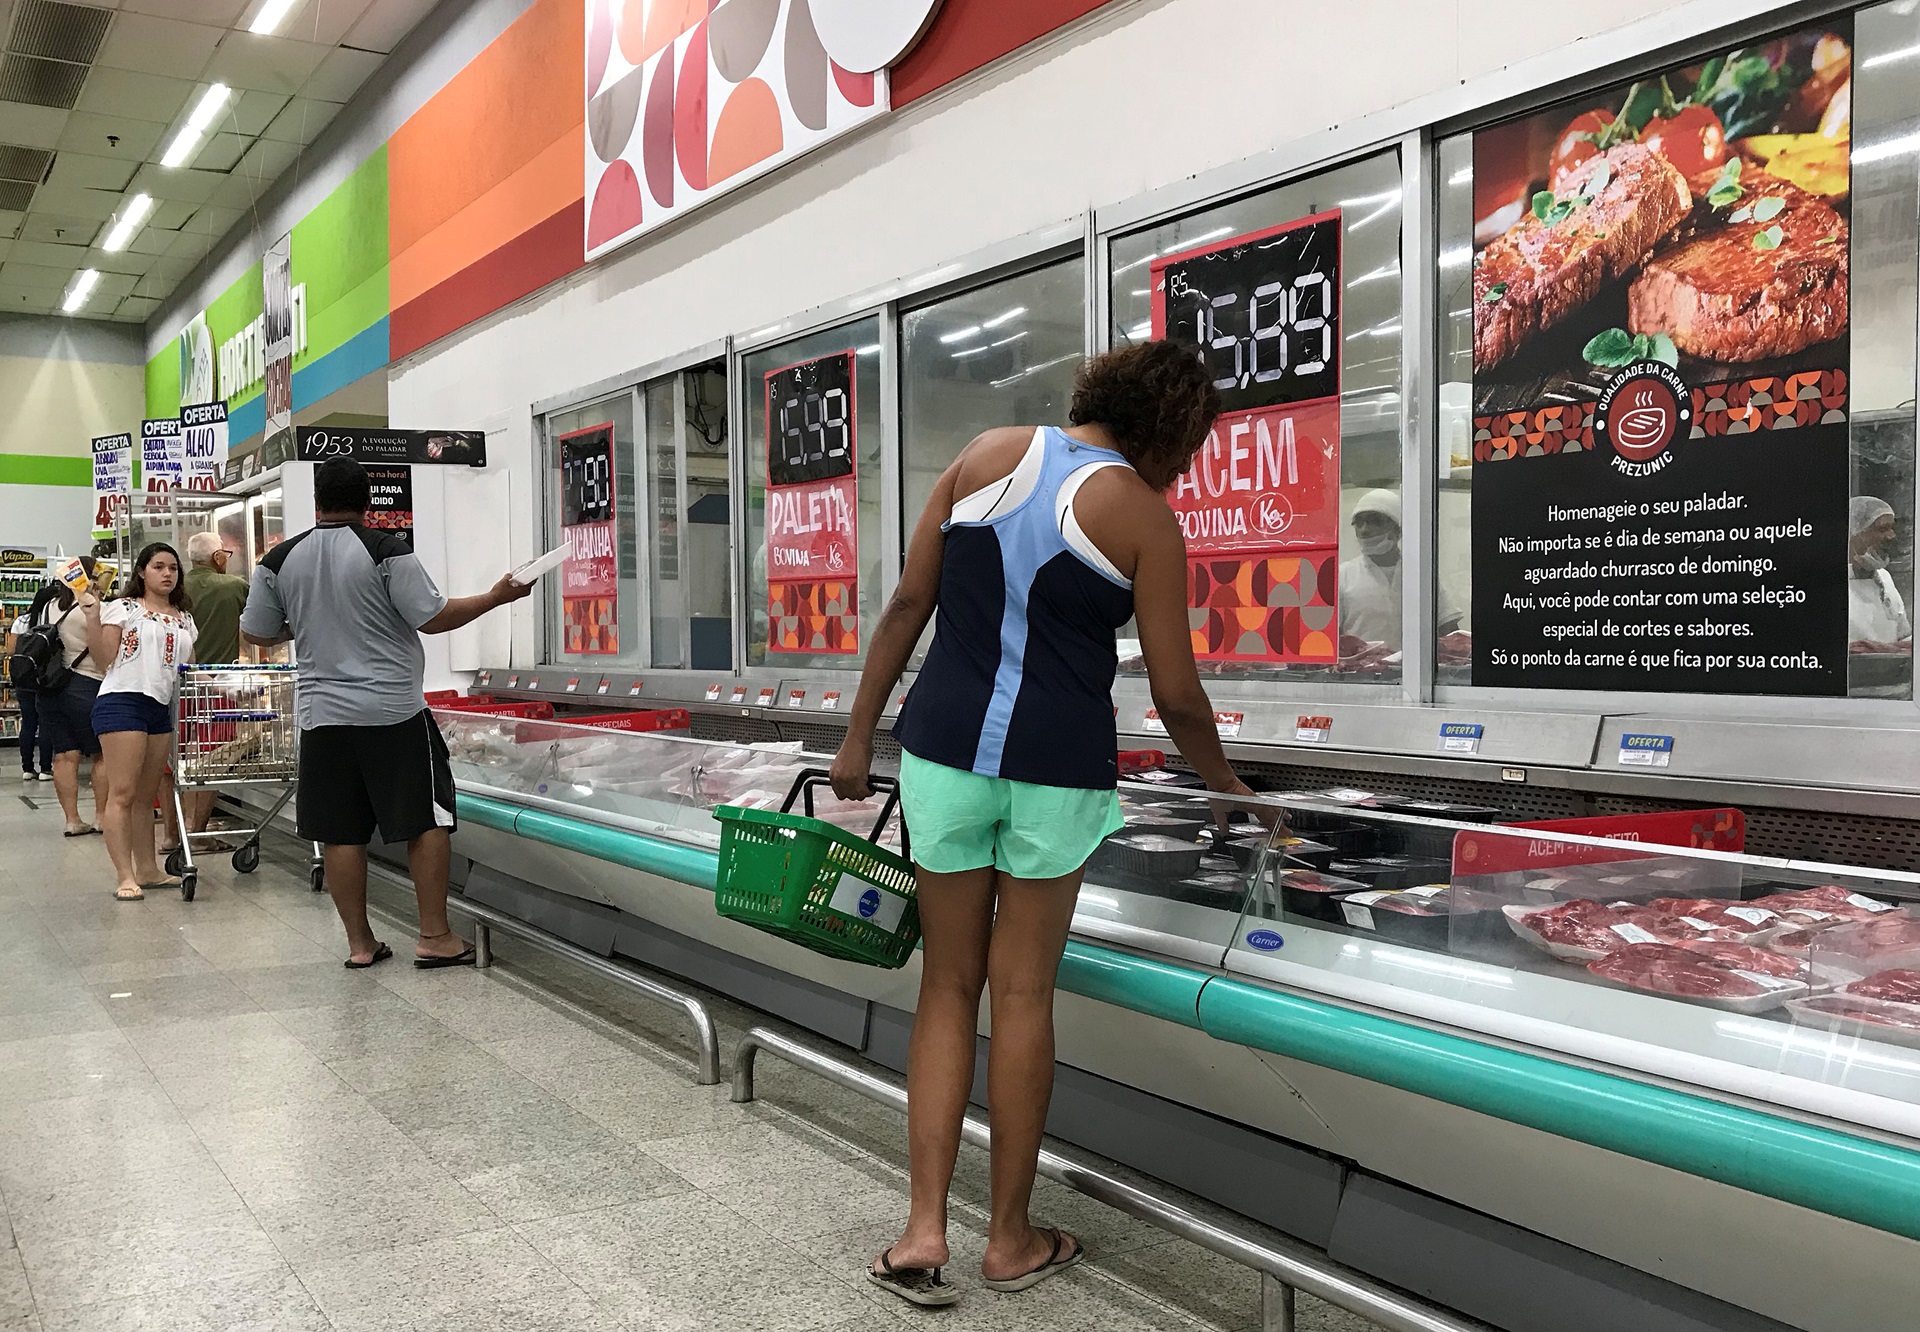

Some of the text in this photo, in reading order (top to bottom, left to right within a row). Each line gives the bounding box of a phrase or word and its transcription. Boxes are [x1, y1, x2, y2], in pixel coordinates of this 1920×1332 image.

[219, 282, 307, 401] HORTIFTI
[1598, 363, 1689, 411] QUALIDADE DA CARNE
[184, 403, 226, 425] OFERTA
[144, 420, 181, 436] OFERT
[95, 435, 130, 451] OFERTA
[185, 427, 215, 458] ALHO
[304, 431, 354, 456] 1953
[369, 436, 407, 446] EVOLUÇÃO
[144, 452, 168, 461] CEBOLA
[1610, 450, 1674, 477] PREZUNIC
[95, 466, 109, 476] UVA
[387, 470, 407, 479] hora!
[380, 485, 403, 494] PARA
[771, 485, 851, 536] PALETA
[1260, 498, 1286, 530] Kg
[1548, 490, 1748, 523] Homenageie o seu paladar.
[564, 526, 613, 562] PICANHA
[1499, 517, 1813, 555] Não importa se é dia de semana ou aquele
[3, 551, 33, 562] Vapza
[773, 546, 810, 567] BOVINA
[1524, 554, 1777, 585] aguardado churrasco de domingo.
[1502, 584, 1806, 614] Aqui, você pode contar com uma seleção
[1542, 617, 1754, 642] especial de cortes e sabores.
[1491, 648, 1823, 673] Só o ponto da carne é que fica por sua conta.
[1445, 725, 1476, 735] OFERTA
[1627, 736, 1665, 748] OFERTA
[1251, 934, 1280, 947] Carrier
